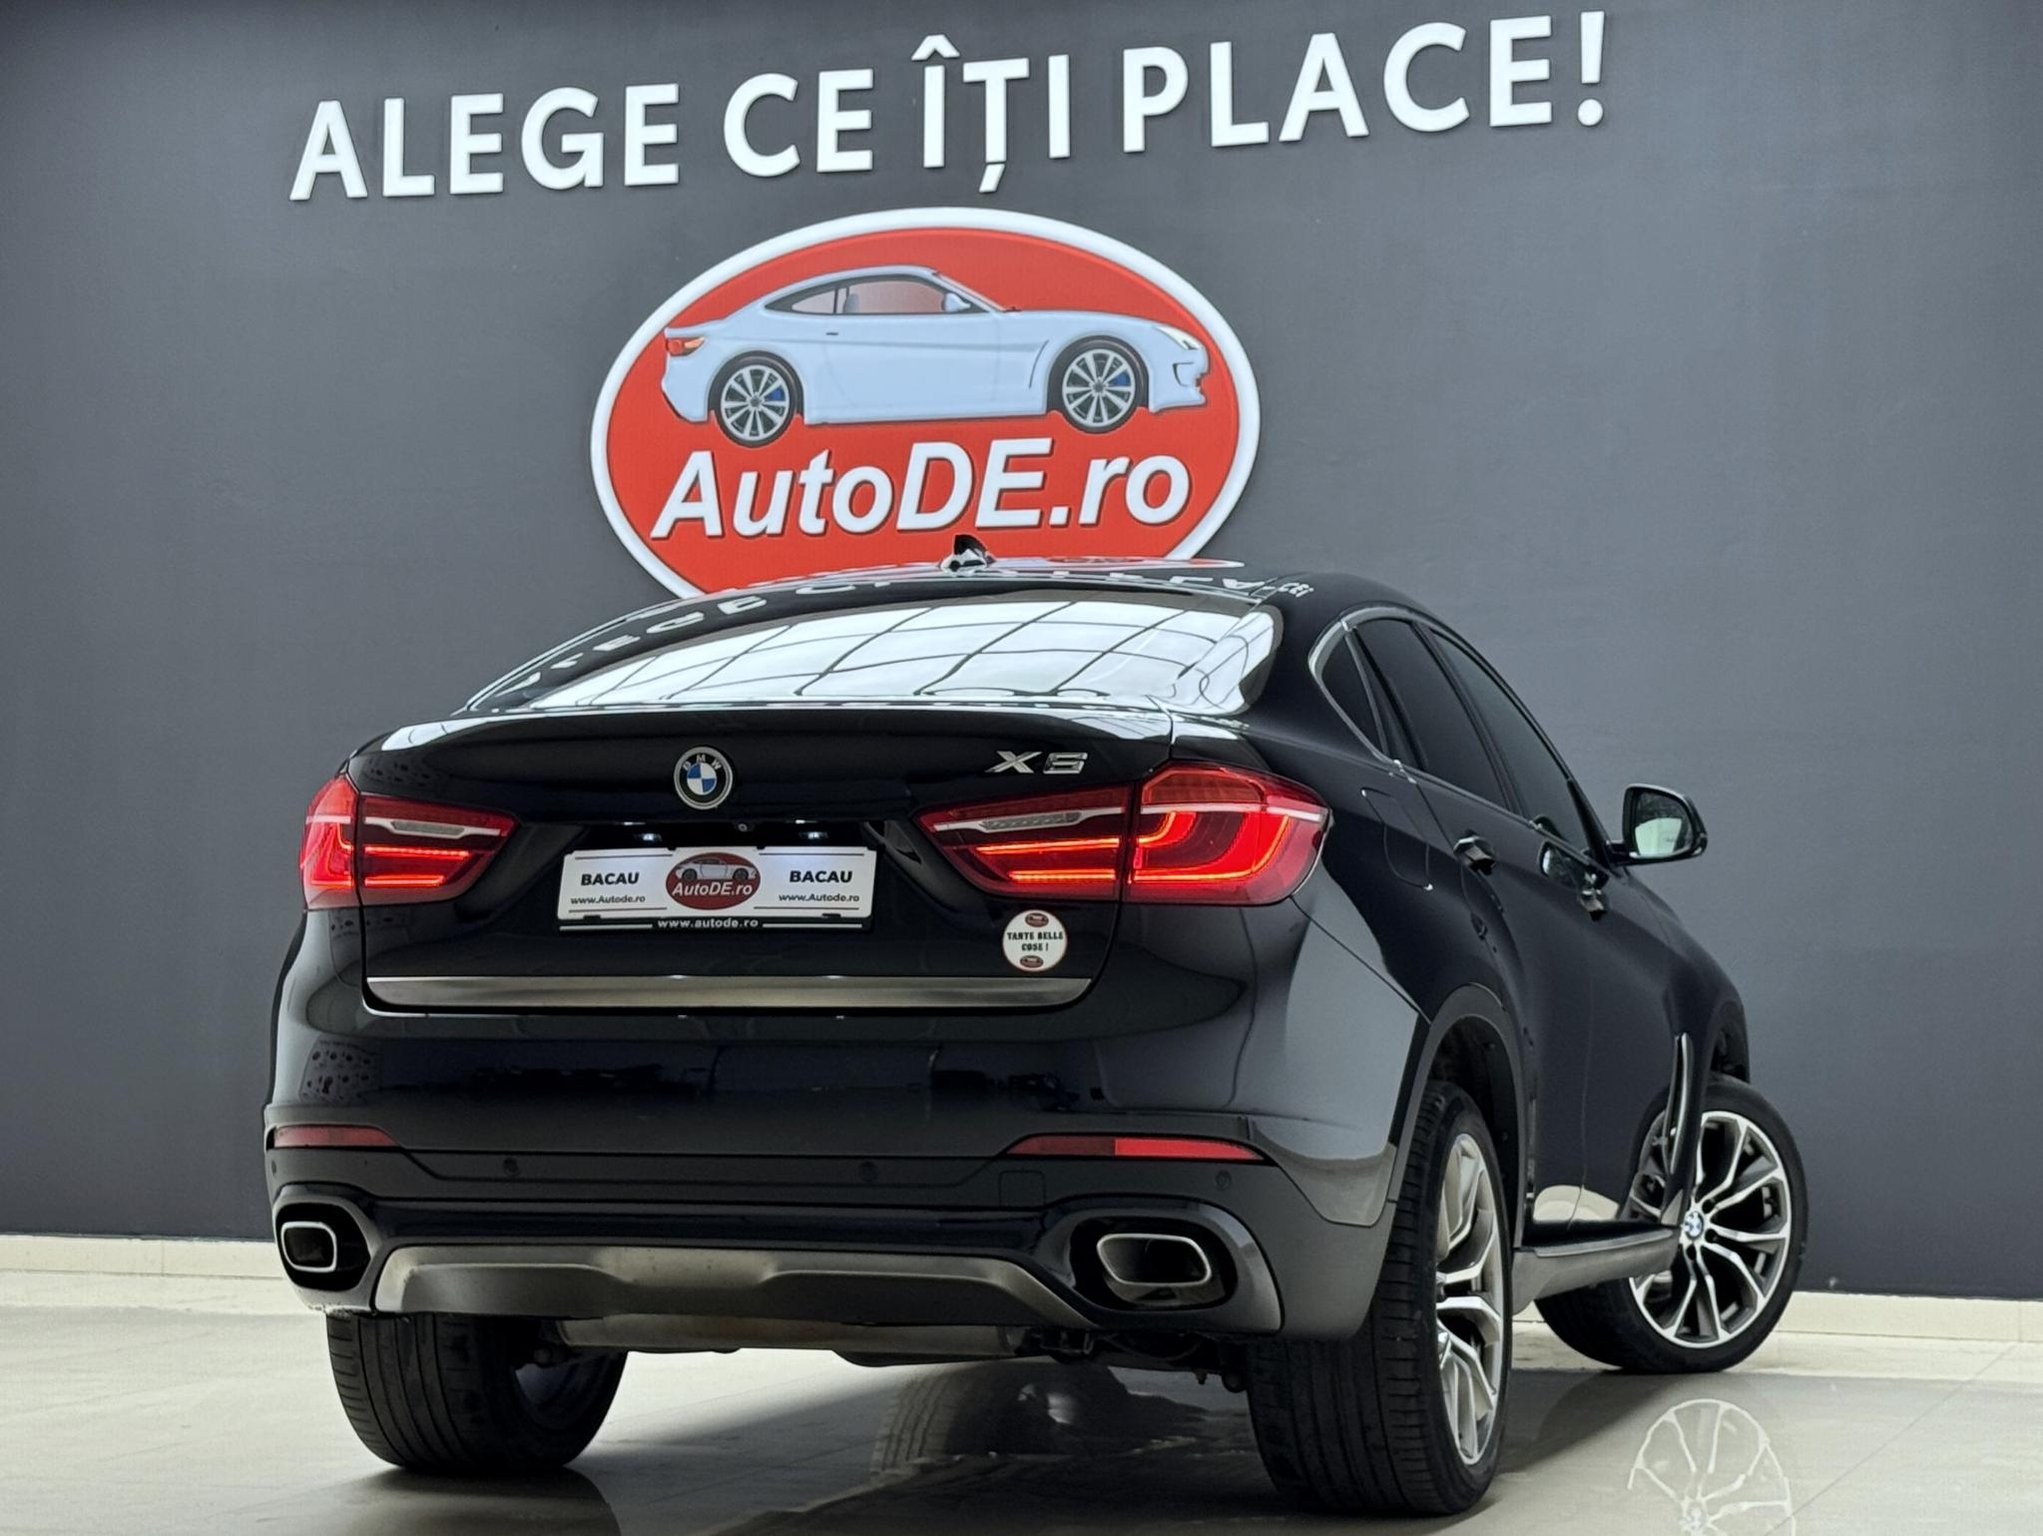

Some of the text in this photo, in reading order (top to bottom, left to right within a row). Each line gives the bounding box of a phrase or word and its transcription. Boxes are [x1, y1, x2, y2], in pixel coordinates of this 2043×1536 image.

[289, 11, 1605, 200] ALEGE CE ÎȚI PLACE!
[650, 437, 1190, 540] AutoDE.ro
[984, 750, 1088, 774] X6
[581, 872, 639, 886] BACAU
[789, 870, 853, 884] BACAU
[672, 880, 753, 897] AutoDE.ro
[570, 895, 646, 905] www.Autode.ro
[778, 893, 860, 903] www.Autode.ro
[657, 918, 759, 929] www.autode.ro
